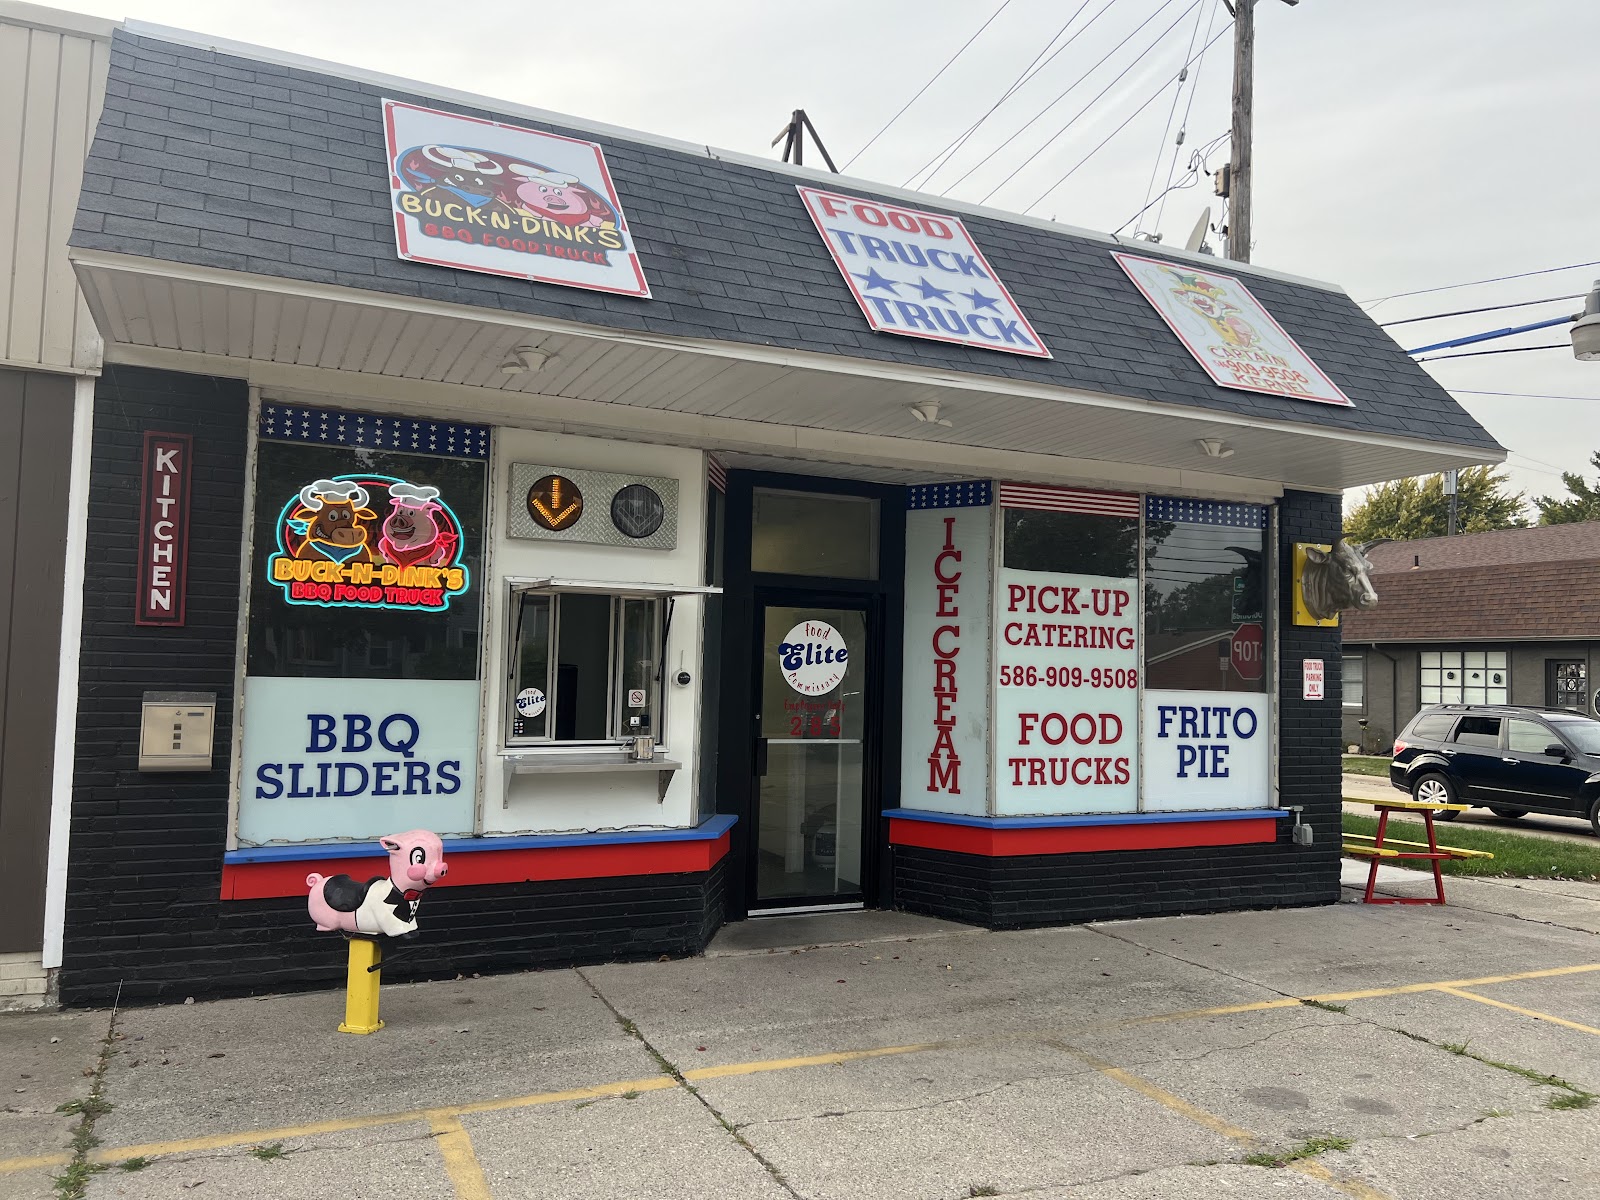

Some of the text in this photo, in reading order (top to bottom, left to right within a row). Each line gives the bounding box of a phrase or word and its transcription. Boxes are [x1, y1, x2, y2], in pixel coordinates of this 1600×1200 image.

[402, 193, 623, 249] BUCK-N-DINK'S
[818, 196, 954, 240] FOOD
[424, 223, 607, 266] BBQ FOOD TRUCK
[827, 228, 990, 279] TRUCK
[862, 294, 1036, 347] TRUCK
[1210, 347, 1289, 368] CAPTAIN
[1233, 372, 1313, 394] KERNEL
[150, 448, 178, 612] KITCHEN
[274, 558, 464, 590] BUCK-N-DINK'S
[292, 582, 444, 605] BBQ FOOD TRUCK
[1007, 584, 1130, 616] PICK-UP
[805, 623, 831, 640] food
[1004, 622, 1135, 650] CATERING
[778, 642, 848, 671] Elite
[927, 517, 962, 794] ICE CREAM
[788, 672, 840, 692] Commissary
[1000, 665, 1138, 689] 586-909-9508
[1306, 673, 1322, 681] PARKING
[1309, 684, 1319, 692] ONLY
[515, 695, 546, 709] Elite
[306, 713, 420, 757] BBQ
[1018, 712, 1123, 745] FOOD
[1157, 705, 1257, 739] FRITO
[1008, 757, 1130, 786] TRUCKS
[1176, 744, 1230, 778] PIE
[255, 760, 461, 799] SLIDERS
